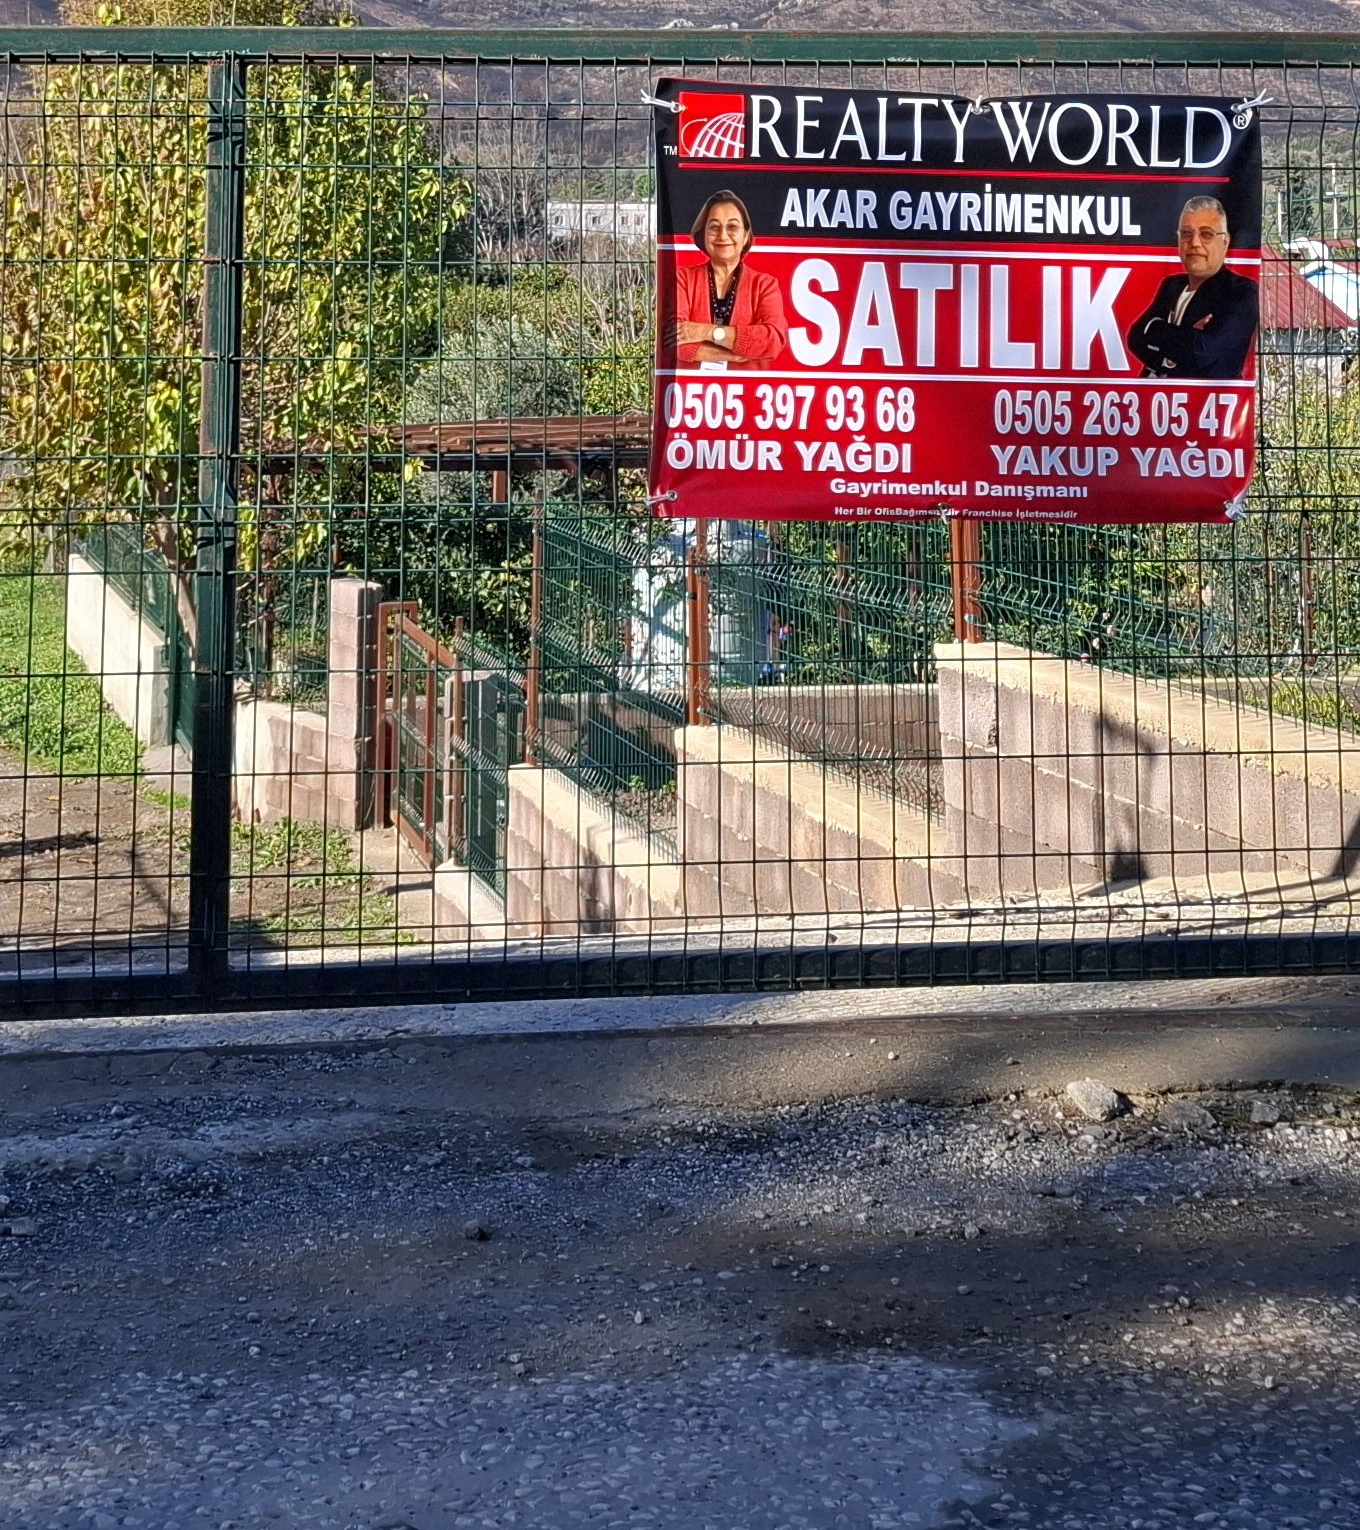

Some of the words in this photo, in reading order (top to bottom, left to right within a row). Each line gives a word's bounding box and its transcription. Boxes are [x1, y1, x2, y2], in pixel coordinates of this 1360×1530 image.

[750, 94, 973, 163] REALTY
[989, 101, 1232, 168] WORLD
[780, 187, 878, 229] AKAR
[889, 183, 1142, 236] GAYRİMENKUL
[789, 258, 1131, 371] SATILIK
[664, 382, 744, 430] 0505
[754, 383, 815, 431] 397
[825, 385, 866, 432] 93
[875, 386, 916, 433] 68
[994, 389, 1072, 436] 0505
[1082, 390, 1141, 437] 263
[1151, 391, 1189, 437] 05
[1198, 392, 1239, 437] 47
[666, 432, 783, 471] ÖMÜR
[793, 435, 912, 474] YAĞDI
[990, 444, 1118, 477] YAKUP
[1131, 441, 1245, 478] YAĞDI
[829, 477, 967, 499] Gayrimenkul
[975, 480, 1089, 502] Danışmanı
[834, 506, 854, 516] Her
[856, 506, 872, 517] Bir
[962, 508, 1013, 519] Franchise
